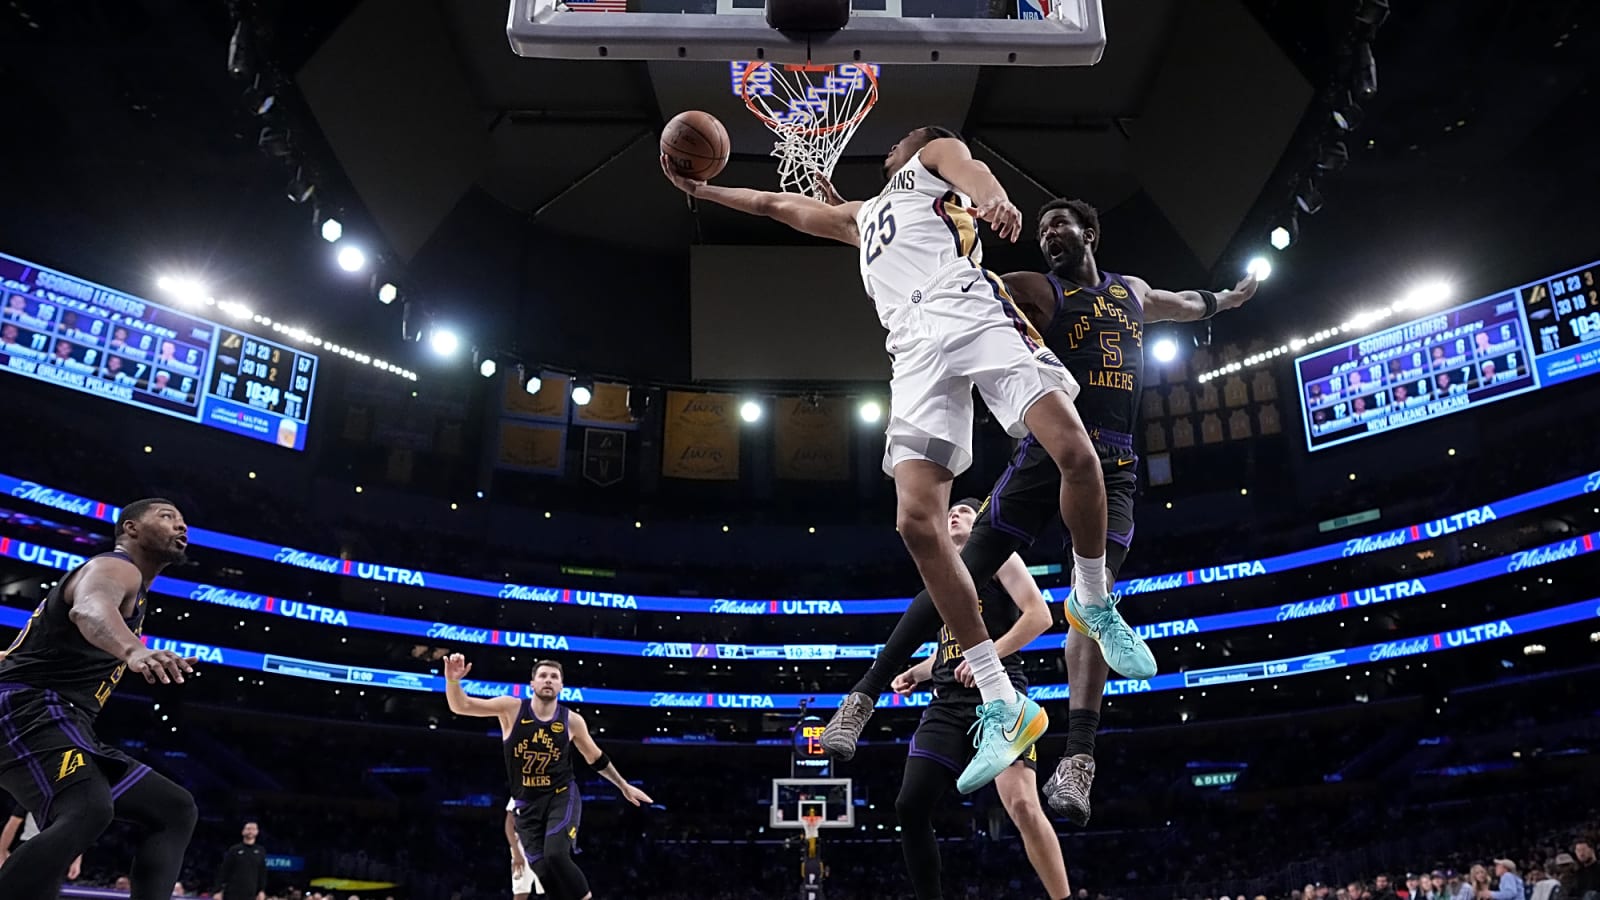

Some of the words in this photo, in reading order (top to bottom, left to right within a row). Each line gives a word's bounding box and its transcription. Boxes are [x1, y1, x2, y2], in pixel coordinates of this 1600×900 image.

[1022, 11, 1039, 20] NBA
[863, 201, 897, 266] 25
[1589, 290, 1598, 305] 2
[1068, 315, 1091, 349] LOS
[1092, 296, 1142, 347] ANGELES
[31, 334, 48, 350] 11
[1359, 330, 1403, 356] SCORING
[1403, 315, 1448, 341] LEADERS
[1099, 331, 1123, 368] 5
[135, 363, 146, 379] 7
[269, 367, 278, 382] 2
[1088, 370, 1134, 391] LAKERS
[1461, 366, 1470, 382] 7
[1375, 391, 1386, 407] 11
[1367, 416, 1388, 431] NEW
[12, 481, 92, 516] Michelob
[1343, 532, 1406, 557] Michelob
[1425, 505, 1497, 537] ULTRA
[274, 547, 338, 574] Michelob
[357, 562, 425, 586] ULTRA
[1507, 541, 1577, 572] Michelob
[1126, 575, 1183, 596] Michelob
[1200, 560, 1266, 583] ULTRA
[190, 584, 261, 611] Michelob
[279, 599, 349, 626] ULTRA
[499, 584, 558, 603] Michelob
[575, 591, 638, 609] ULTRA
[710, 599, 766, 614] Michelob
[783, 600, 843, 614] ULTRA
[1276, 597, 1336, 622] Michelob
[1355, 578, 1426, 606] ULTRA
[426, 622, 488, 643] Michelob
[505, 631, 569, 650] ULTRA
[1137, 619, 1199, 640] ULTRA
[1369, 638, 1429, 661] Michelob
[1446, 620, 1513, 647] ULTRA
[154, 638, 224, 664] ULTRA
[525, 686, 584, 701] URA
[650, 695, 702, 707] Michelob
[718, 695, 774, 708] ULTRA
[514, 739, 528, 758] LOS
[531, 728, 561, 761] ANGELES
[522, 750, 552, 774] 77
[522, 775, 551, 787] LAKERS
